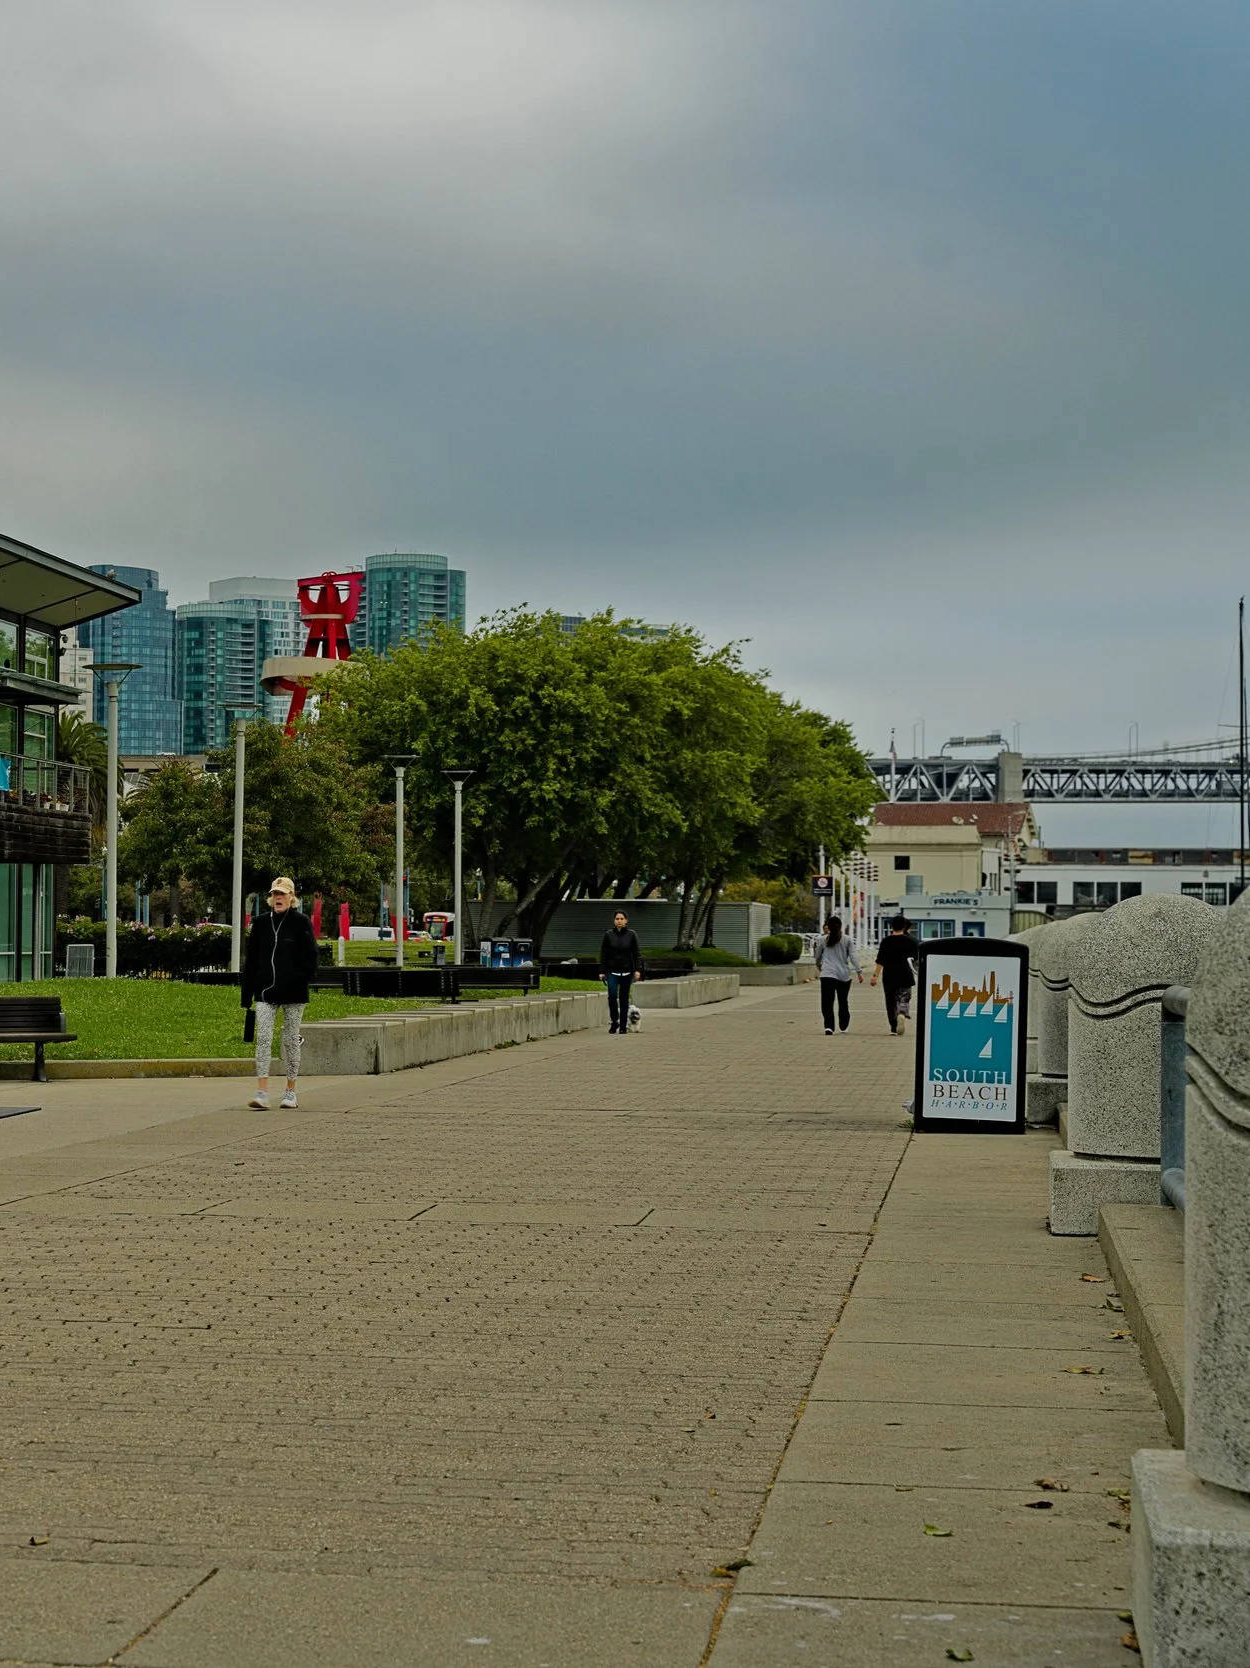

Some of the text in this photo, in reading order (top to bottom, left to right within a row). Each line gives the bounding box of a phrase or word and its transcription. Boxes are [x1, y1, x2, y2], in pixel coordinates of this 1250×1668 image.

[933, 898, 978, 906] FRANKIE'S
[933, 1068, 1007, 1084] SOUTH
[932, 1084, 1008, 1101] BEACH
